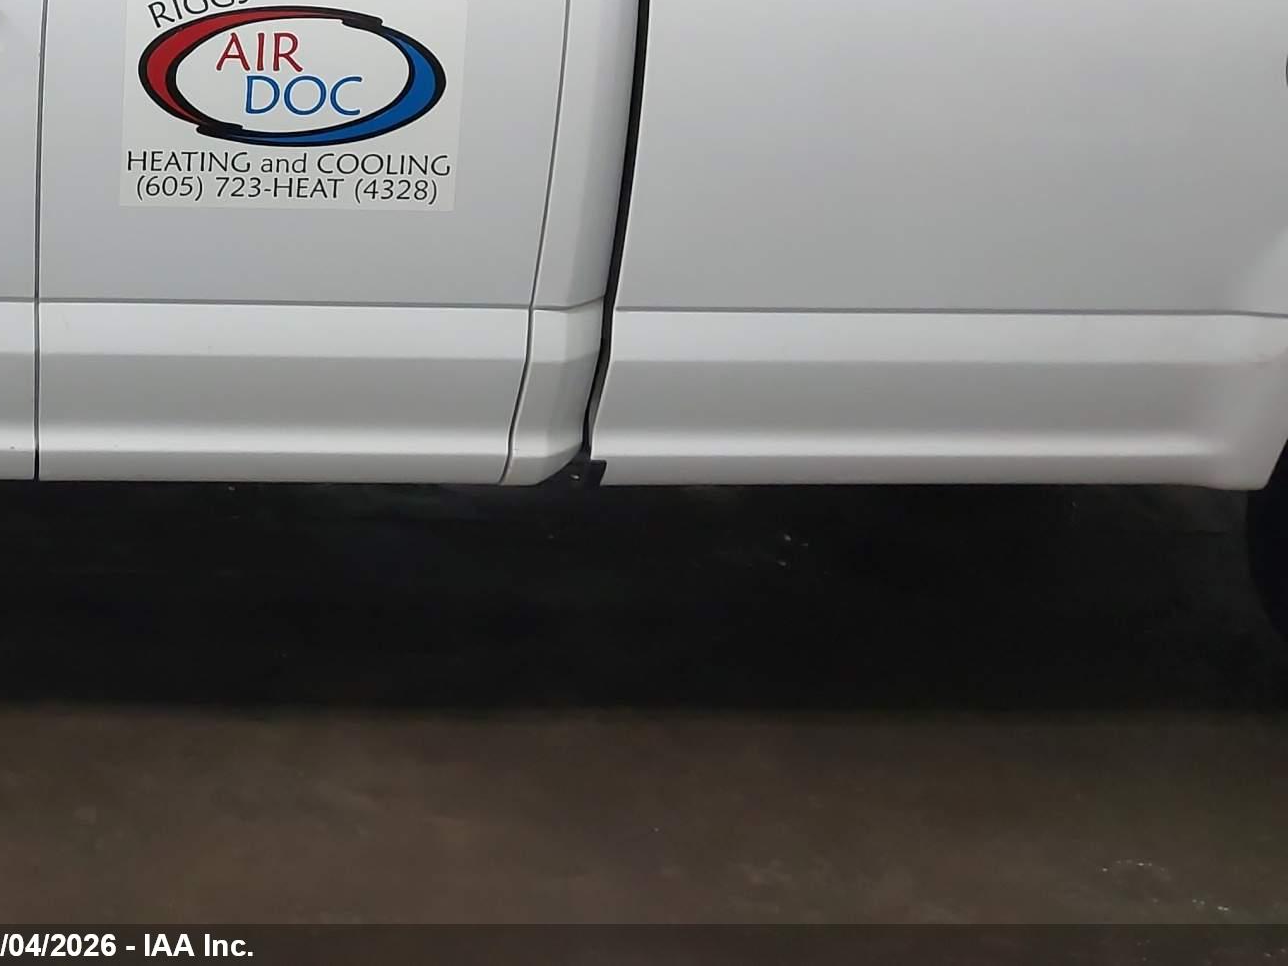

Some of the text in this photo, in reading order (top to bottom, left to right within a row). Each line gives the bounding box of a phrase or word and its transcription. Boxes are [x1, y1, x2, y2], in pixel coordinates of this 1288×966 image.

[216, 32, 304, 72] AIR
[245, 75, 363, 116] DOC
[127, 150, 450, 176] HEATING and COOLING
[137, 176, 438, 204] (605) 723-HEAT (4328)
